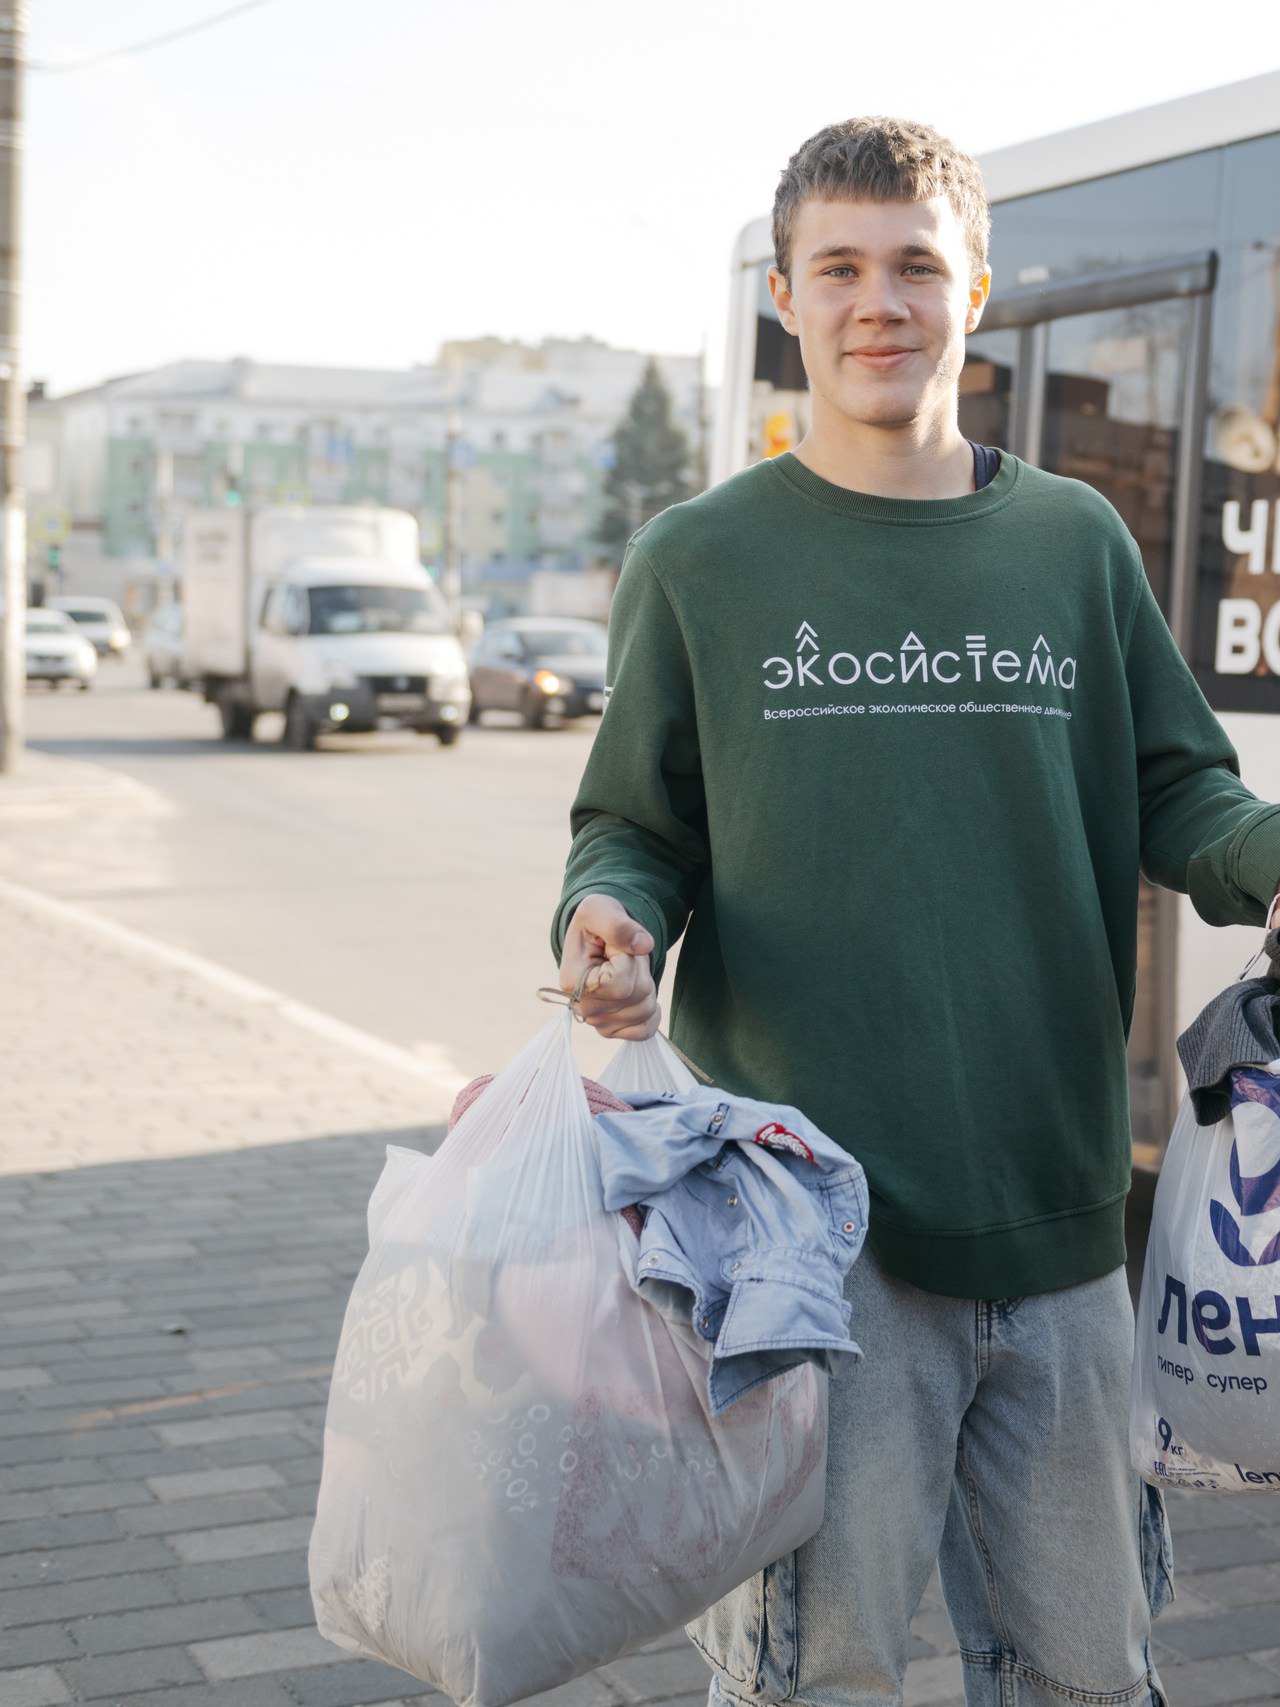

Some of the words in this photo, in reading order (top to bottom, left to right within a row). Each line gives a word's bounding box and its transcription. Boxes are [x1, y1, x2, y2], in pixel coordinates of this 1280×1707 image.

[762, 620, 1077, 690] экосистема
[764, 704, 865, 720] Всероссийское
[868, 703, 956, 714] экологическое
[959, 702, 1042, 714] общественное
[1158, 1355, 1194, 1385] гипер
[1206, 1373, 1268, 1394] супер
[1158, 1417, 1173, 1452] 9
[1170, 1444, 1184, 1456] кг
